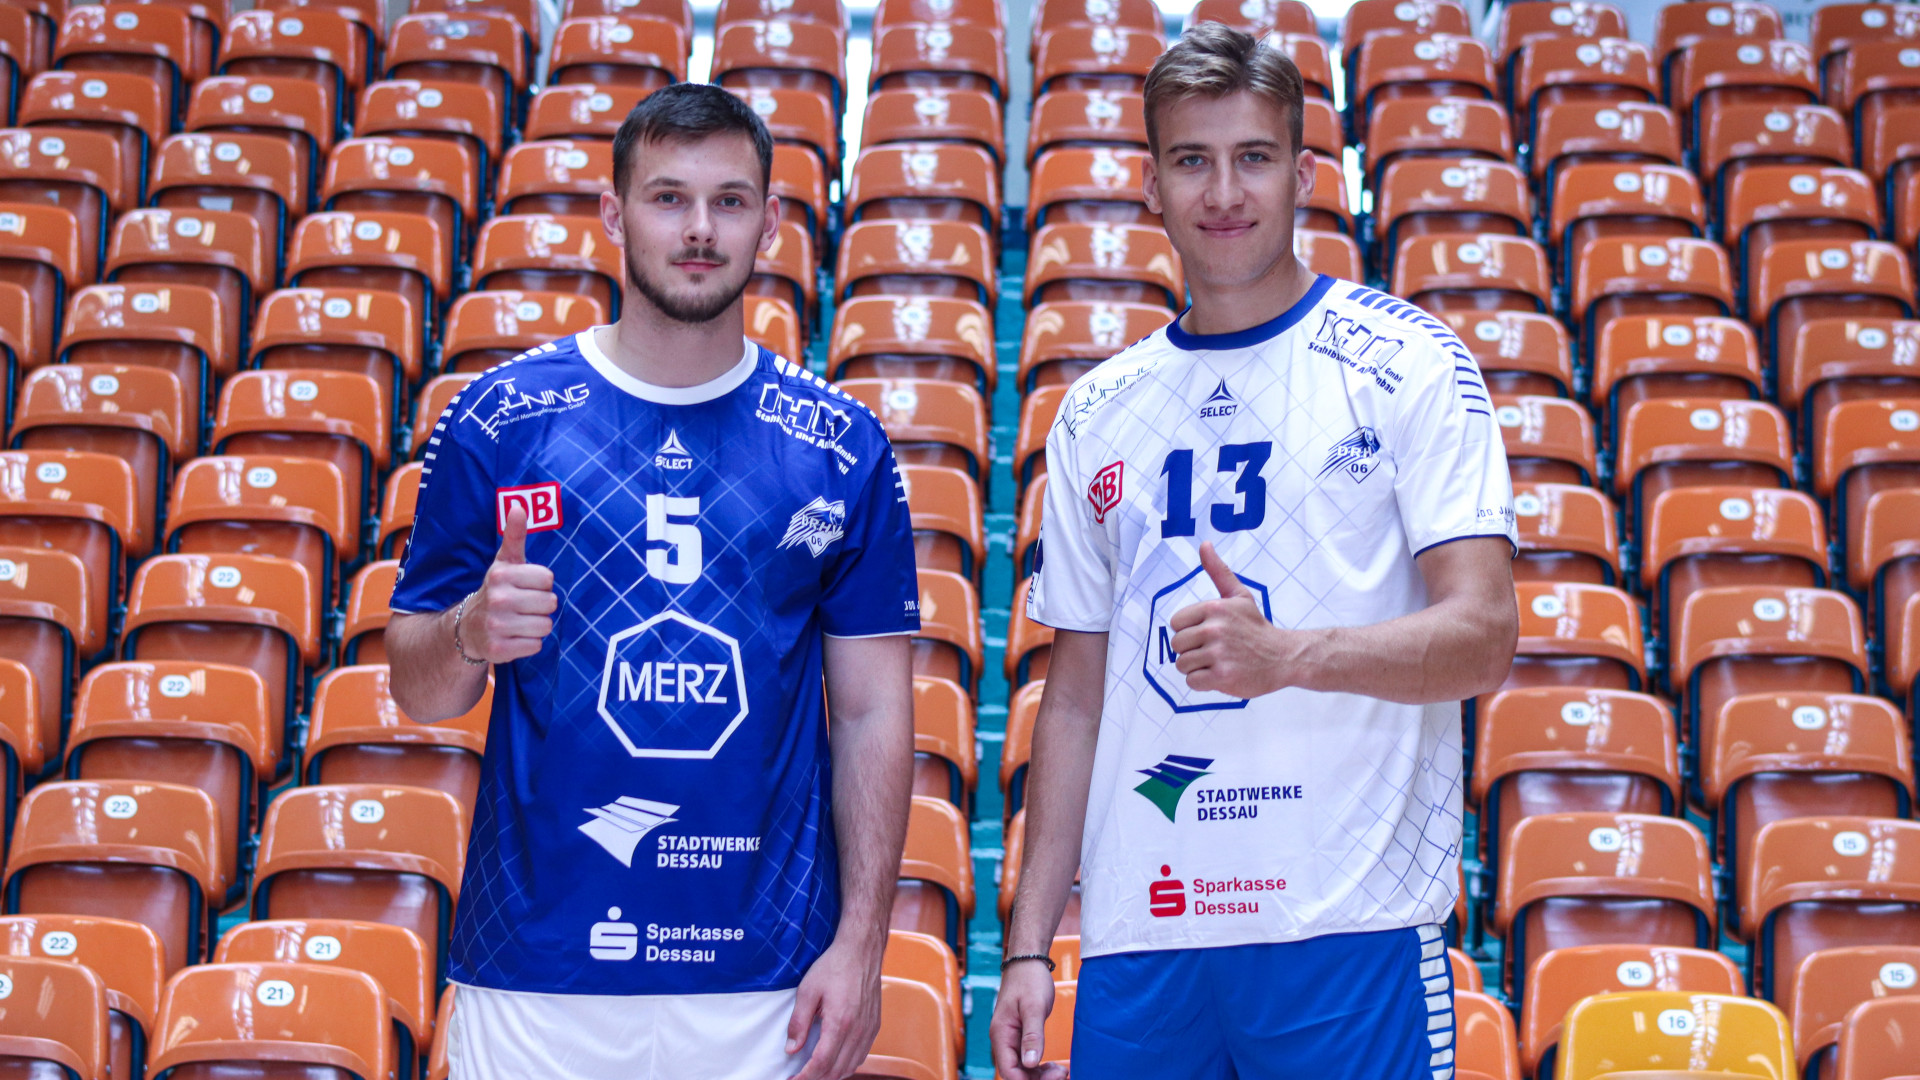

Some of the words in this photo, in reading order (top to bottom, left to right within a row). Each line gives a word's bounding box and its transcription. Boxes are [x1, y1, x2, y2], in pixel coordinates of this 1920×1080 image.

[98, 380, 113, 391] 23
[296, 386, 312, 396] 22
[1200, 405, 1238, 418] SELECT
[795, 431, 816, 445] und
[655, 456, 693, 470] SELECT
[1350, 463, 1368, 474] 06
[44, 467, 60, 478] 23
[254, 472, 271, 483] 22
[1159, 441, 1273, 539] 13
[503, 491, 554, 525] DB
[646, 493, 703, 585] 5
[217, 572, 235, 583] 22
[1762, 604, 1776, 614] 15
[167, 680, 185, 692] 22
[618, 662, 728, 704] MERZ
[1571, 708, 1585, 719] 16
[1801, 713, 1816, 724] 15
[1197, 785, 1303, 804] STADTWERKE
[111, 801, 130, 813] 22
[359, 805, 376, 817] 21
[1197, 805, 1258, 821] DESSAU
[657, 835, 761, 853] STADTWERKE
[1598, 833, 1613, 845] 16
[1842, 838, 1858, 850] 15
[657, 853, 723, 869] DESSAU
[1193, 877, 1287, 896] Sparkasse
[1195, 900, 1259, 915] Dessau
[646, 923, 744, 943] Sparkasse
[49, 936, 70, 950] 22
[314, 941, 332, 954] 21
[646, 945, 716, 962] Dessau
[1626, 967, 1643, 980] 16
[1890, 970, 1906, 983] 15
[266, 986, 284, 1000] 21
[1668, 1016, 1687, 1029] 16
